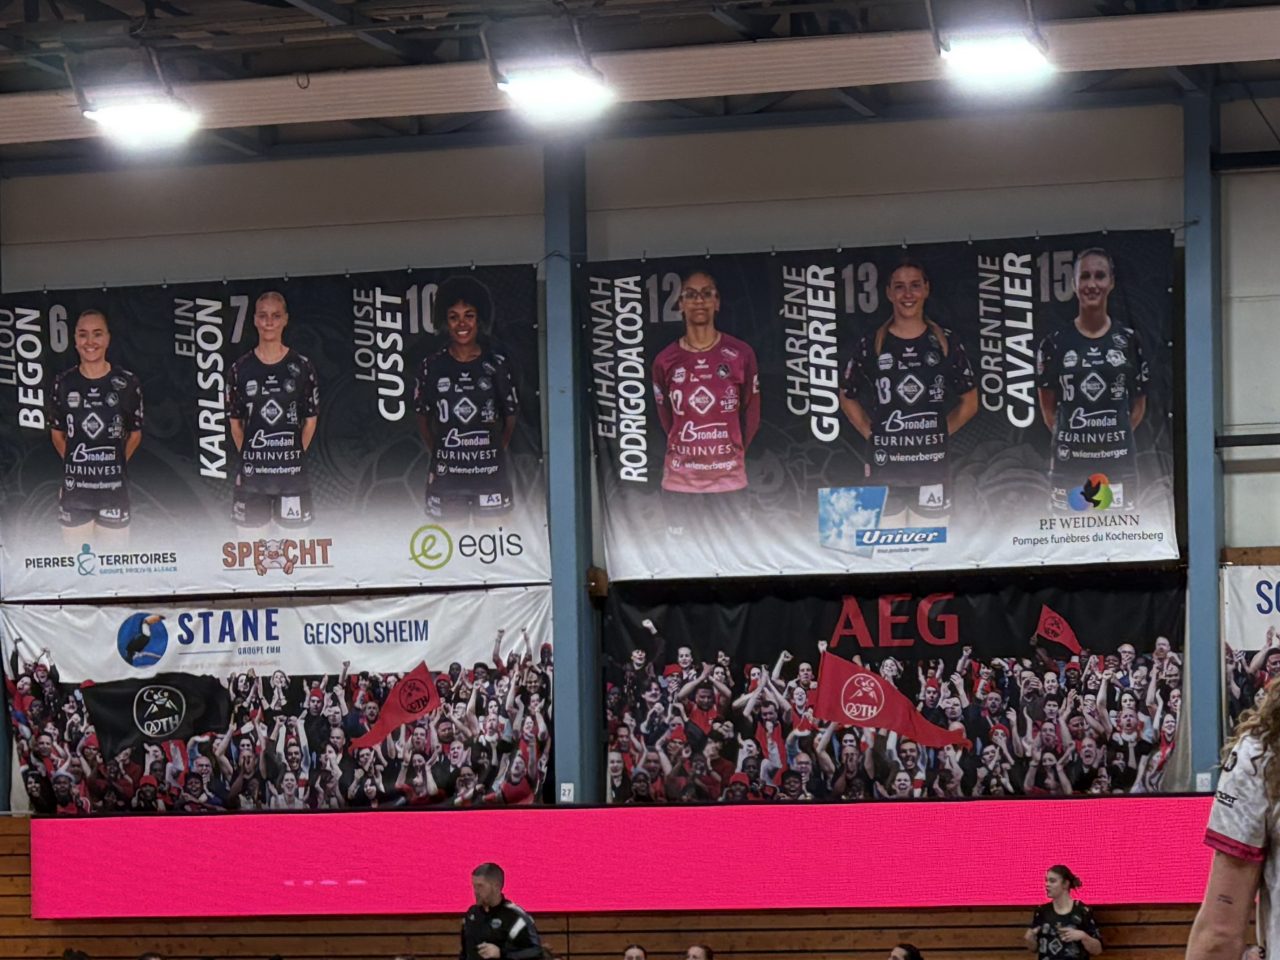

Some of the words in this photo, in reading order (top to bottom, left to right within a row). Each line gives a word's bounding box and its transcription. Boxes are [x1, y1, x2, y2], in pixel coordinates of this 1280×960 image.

[646, 272, 682, 323] 12
[842, 262, 879, 314] 13
[1036, 250, 1074, 303] 15
[49, 304, 69, 353] 6
[174, 298, 196, 358] ELIN
[230, 295, 249, 344] 7
[353, 288, 376, 382] LOUISE
[615, 275, 644, 345] COSTA
[978, 255, 1004, 411] CORENTINE
[0, 308, 17, 386] LILOU
[375, 287, 406, 421] CUSSET
[589, 277, 617, 439] ELIHANNAH
[617, 347, 645, 379] DA
[779, 265, 810, 416] CHARLÈNE
[806, 264, 841, 442] GUERRIER
[1003, 252, 1036, 428] CAVALIER
[15, 307, 45, 430] BEGON
[196, 298, 228, 480] KARLSSON
[875, 376, 892, 404] 13
[617, 380, 648, 483] RODRIGO
[873, 433, 945, 446] EURINVEST
[881, 410, 939, 432] Brondani
[1058, 430, 1126, 443] EURINVEST
[242, 450, 302, 460] EURINVEST
[437, 449, 497, 460] EURINVEST
[889, 451, 945, 462] wienerberger
[458, 526, 524, 564] egis
[862, 530, 938, 544] Univer
[1012, 535, 1049, 546] Pompes
[1050, 533, 1091, 544] funèbres
[1092, 533, 1104, 542] du
[1105, 530, 1164, 543] Kochersberg
[1059, 514, 1140, 530] WEIDMANN
[25, 556, 75, 568] PIERRES
[98, 552, 177, 566] TERRITOIRES
[177, 608, 281, 645] STANE
[303, 618, 429, 645] GEISPOLSHEIM
[829, 593, 961, 648] AEG
